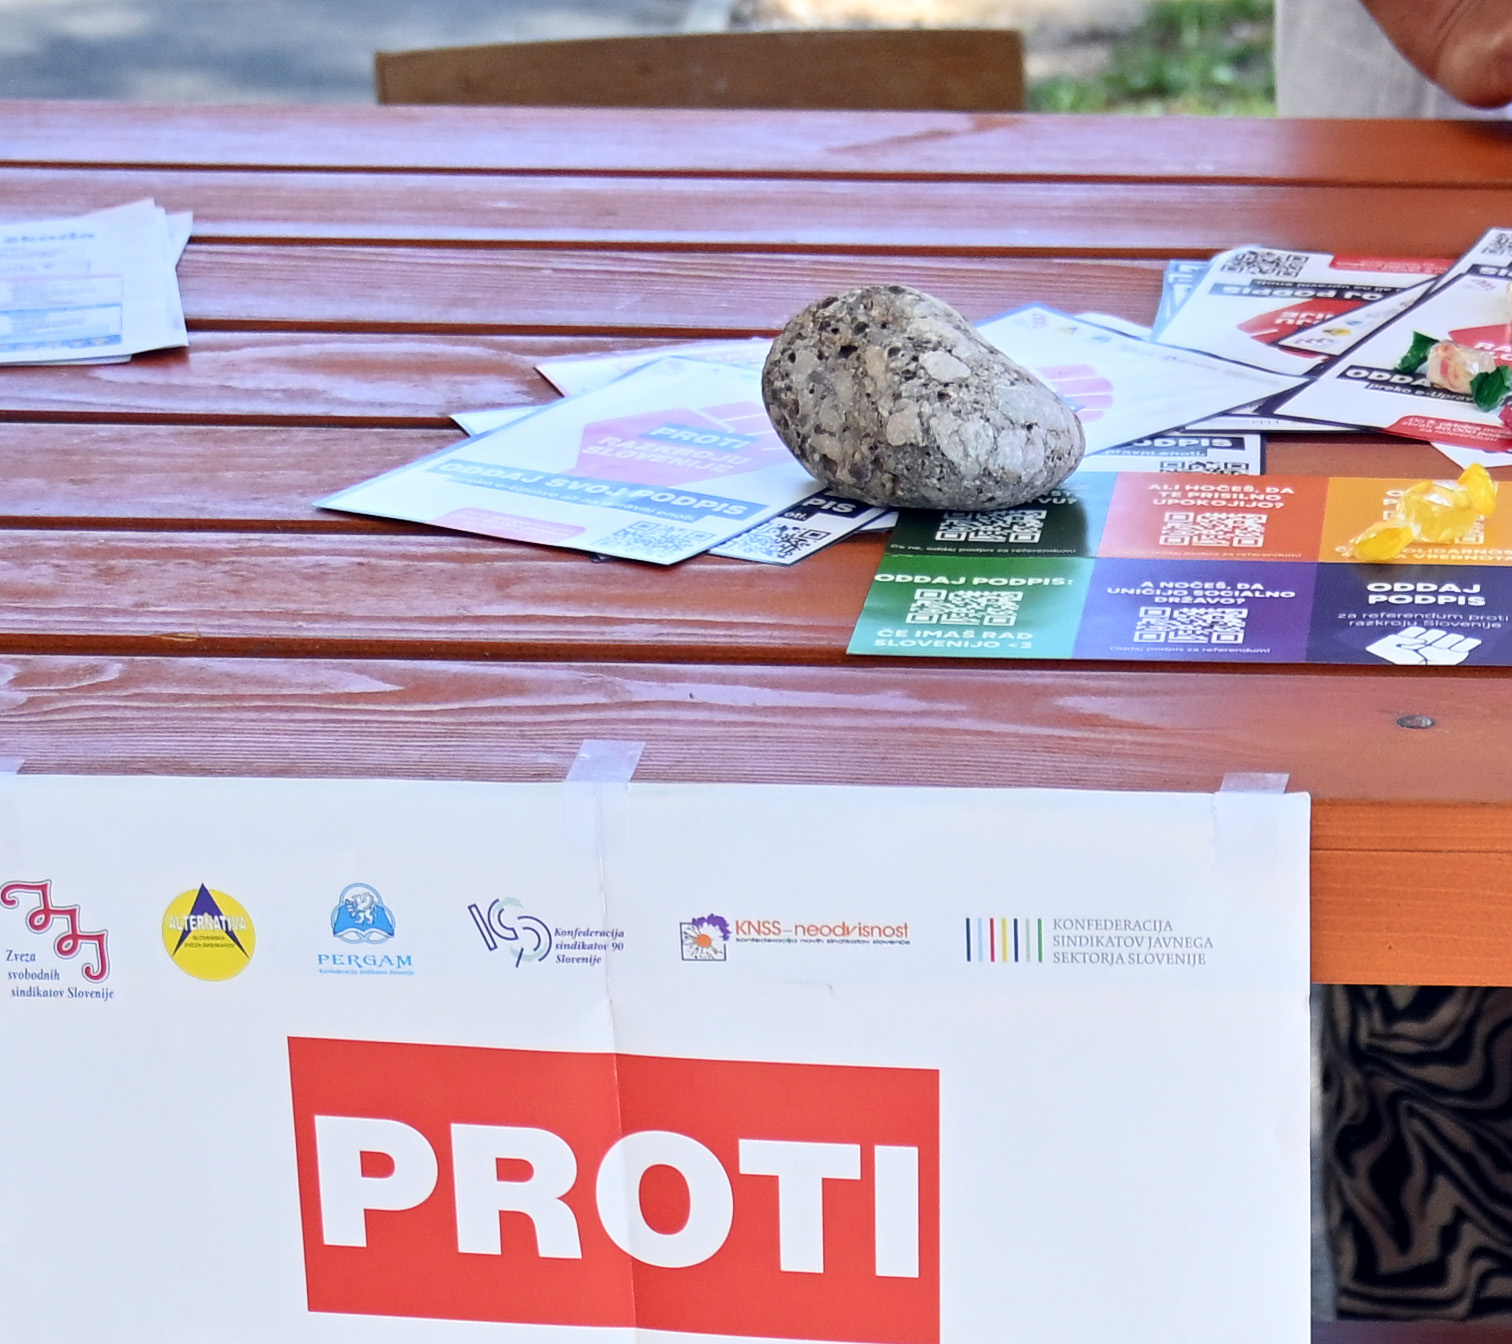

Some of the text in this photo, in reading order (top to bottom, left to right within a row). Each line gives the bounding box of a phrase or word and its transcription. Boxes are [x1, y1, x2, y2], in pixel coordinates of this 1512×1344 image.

[1148, 484, 1179, 492] ALI
[1266, 486, 1294, 495] DA
[1185, 492, 1282, 502] PRISILNO
[1153, 499, 1284, 509] UPOKOJIJO?
[874, 573, 971, 585] ODDAJ
[1107, 587, 1296, 598] UNIČIJO SOCIALNO
[1366, 583, 1481, 594] ODDAJ
[1154, 595, 1246, 605] DRŽAVO?
[1367, 594, 1486, 606] PODPIS
[169, 914, 246, 931] ALTERNATIVA
[1053, 919, 1173, 933] KONFEDERACIJA
[555, 927, 625, 939] Konfederacija
[555, 941, 624, 951] sindikatov 90
[1053, 936, 1213, 950] SINDIKATOV JAVNEGA
[6, 950, 36, 963] Zveza
[318, 954, 412, 968] PERGAM
[556, 954, 602, 966] Slovenije
[1053, 953, 1206, 967] SEKTORJA SLOVENIJE
[8, 969, 60, 980] svobodnih
[12, 987, 114, 1001] sindikatov Slovenije
[314, 1115, 919, 1277] PROTI
